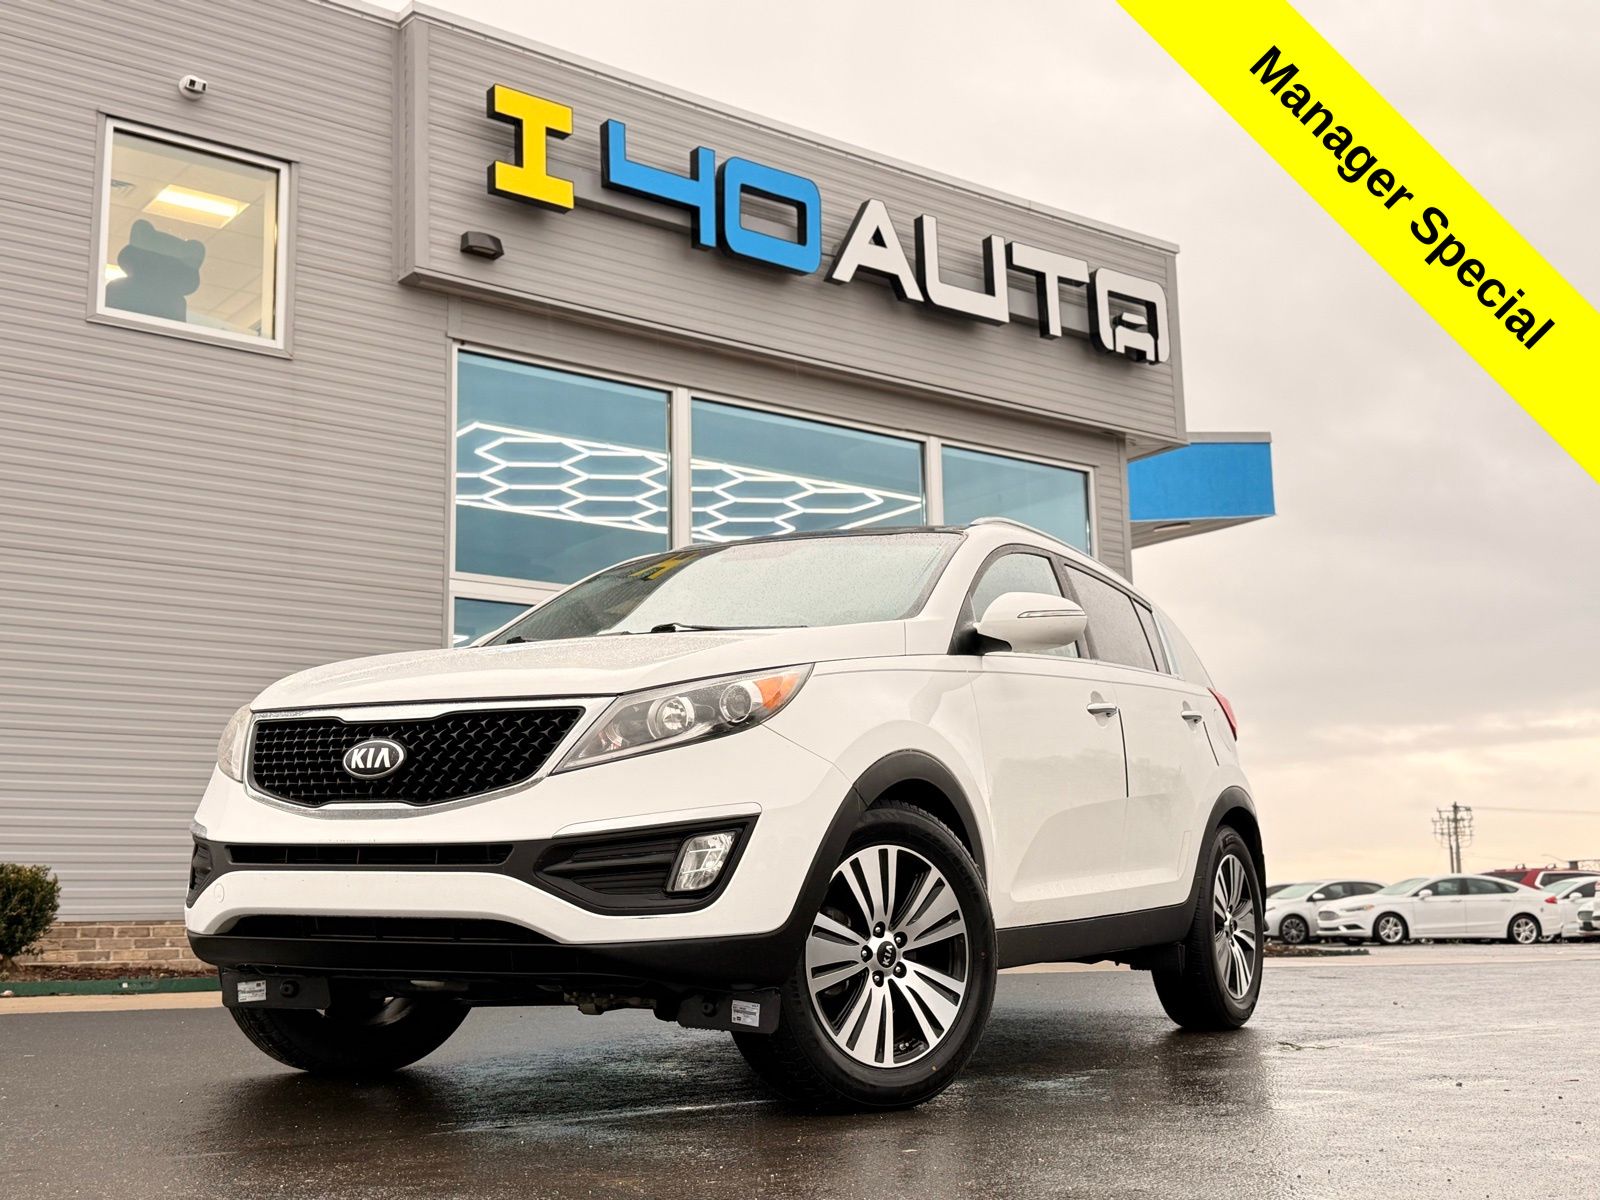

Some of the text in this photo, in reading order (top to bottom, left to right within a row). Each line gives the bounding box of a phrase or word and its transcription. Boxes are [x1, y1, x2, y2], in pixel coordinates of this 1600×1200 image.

[487, 83, 574, 213] I
[601, 118, 822, 276] 40
[350, 747, 391, 769] KIA
[882, 945, 893, 966] KIA
